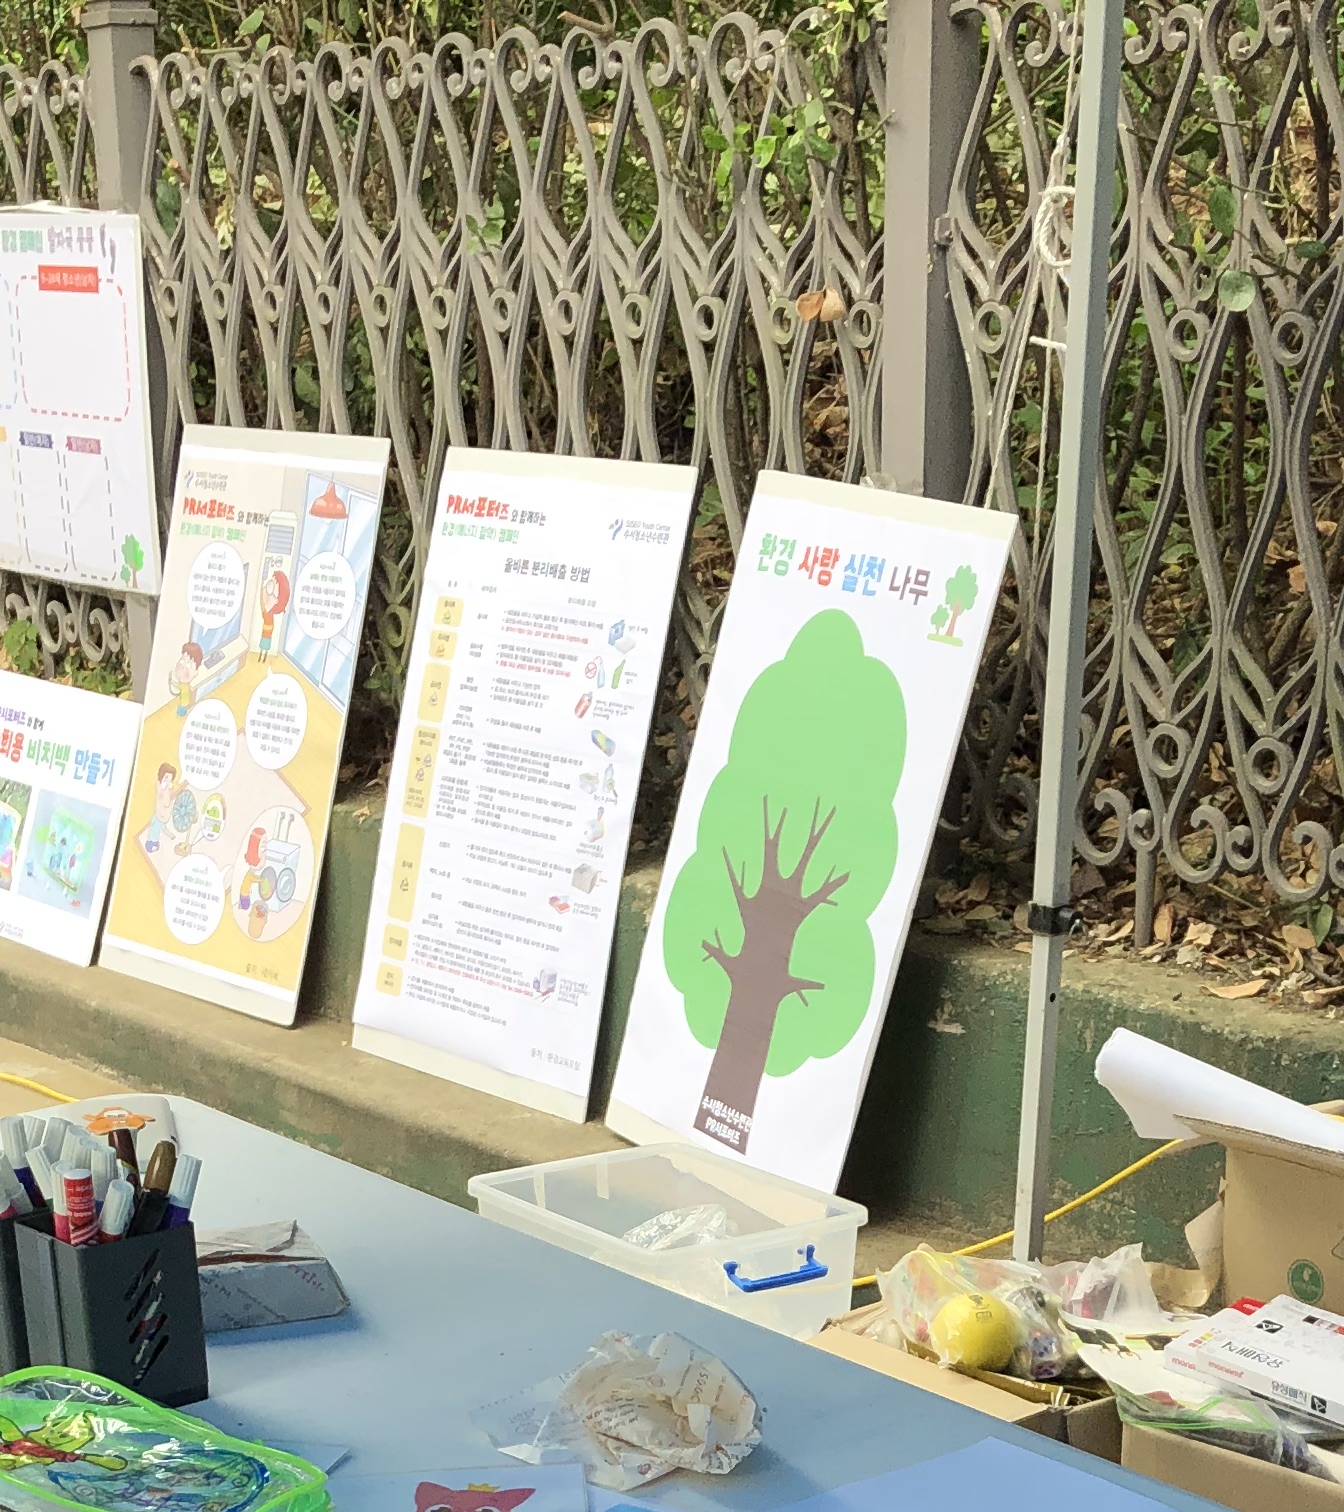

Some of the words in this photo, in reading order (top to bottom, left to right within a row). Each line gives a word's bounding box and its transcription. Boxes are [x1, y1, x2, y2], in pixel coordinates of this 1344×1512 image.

[504, 557, 531, 575] 올바른
[531, 560, 567, 580] 분리배출
[570, 566, 591, 584] 방법
[757, 532, 797, 577] 환경
[798, 545, 840, 587] 사랑
[841, 554, 886, 597] 실천
[888, 565, 931, 606] 나무
[27, 739, 71, 775] 비치백
[74, 749, 116, 787] 만들기
